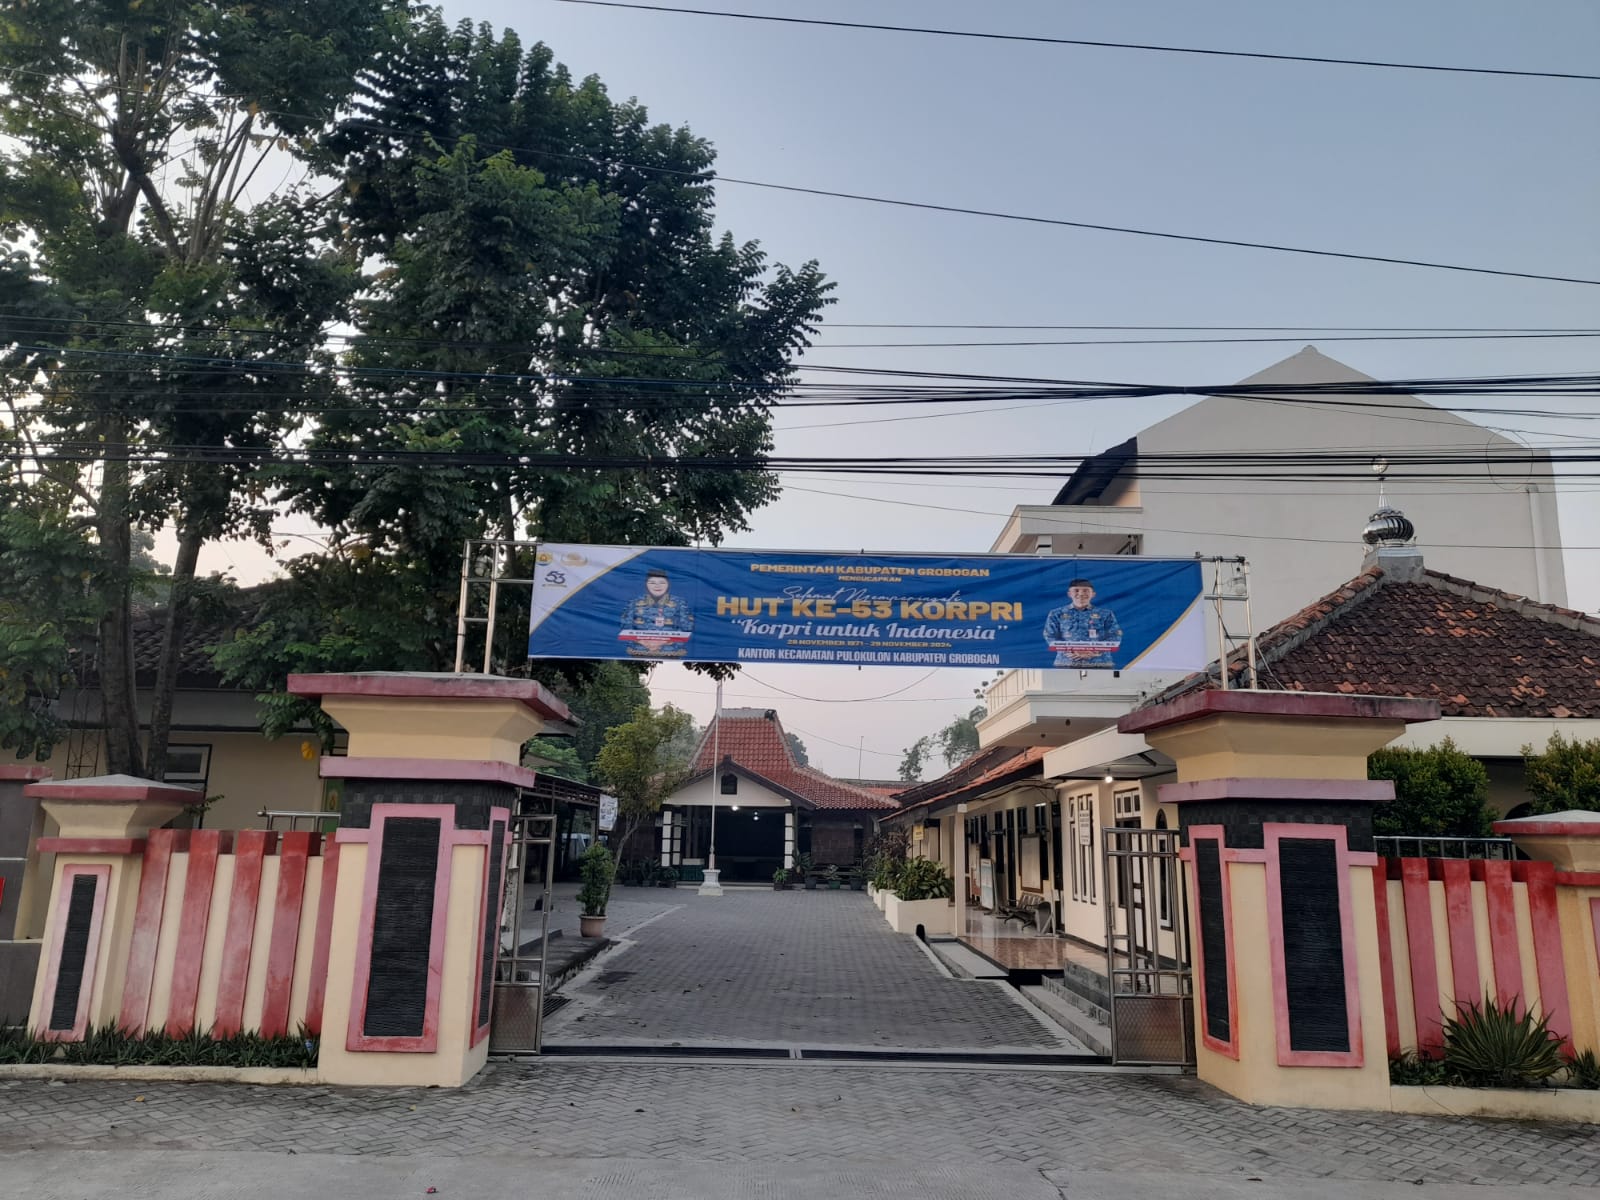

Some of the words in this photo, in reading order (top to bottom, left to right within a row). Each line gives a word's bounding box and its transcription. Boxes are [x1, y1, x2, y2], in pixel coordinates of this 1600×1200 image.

[751, 563, 834, 574] PEMERINTAH
[836, 566, 915, 576] KABUPATEN
[917, 568, 990, 577] GROBOGAN
[838, 575, 902, 583] MENGUCAPKAN
[716, 596, 784, 617] HUT
[792, 599, 892, 619] KE-53
[901, 601, 1023, 621] KORPRI
[816, 623, 881, 639] untuk
[738, 647, 776, 659] KANTOR
[778, 649, 834, 661] KECAMATAN
[836, 650, 890, 662] PULOKULON
[893, 651, 947, 663] KABUPATEN
[949, 653, 1000, 665] GROBOGAN
